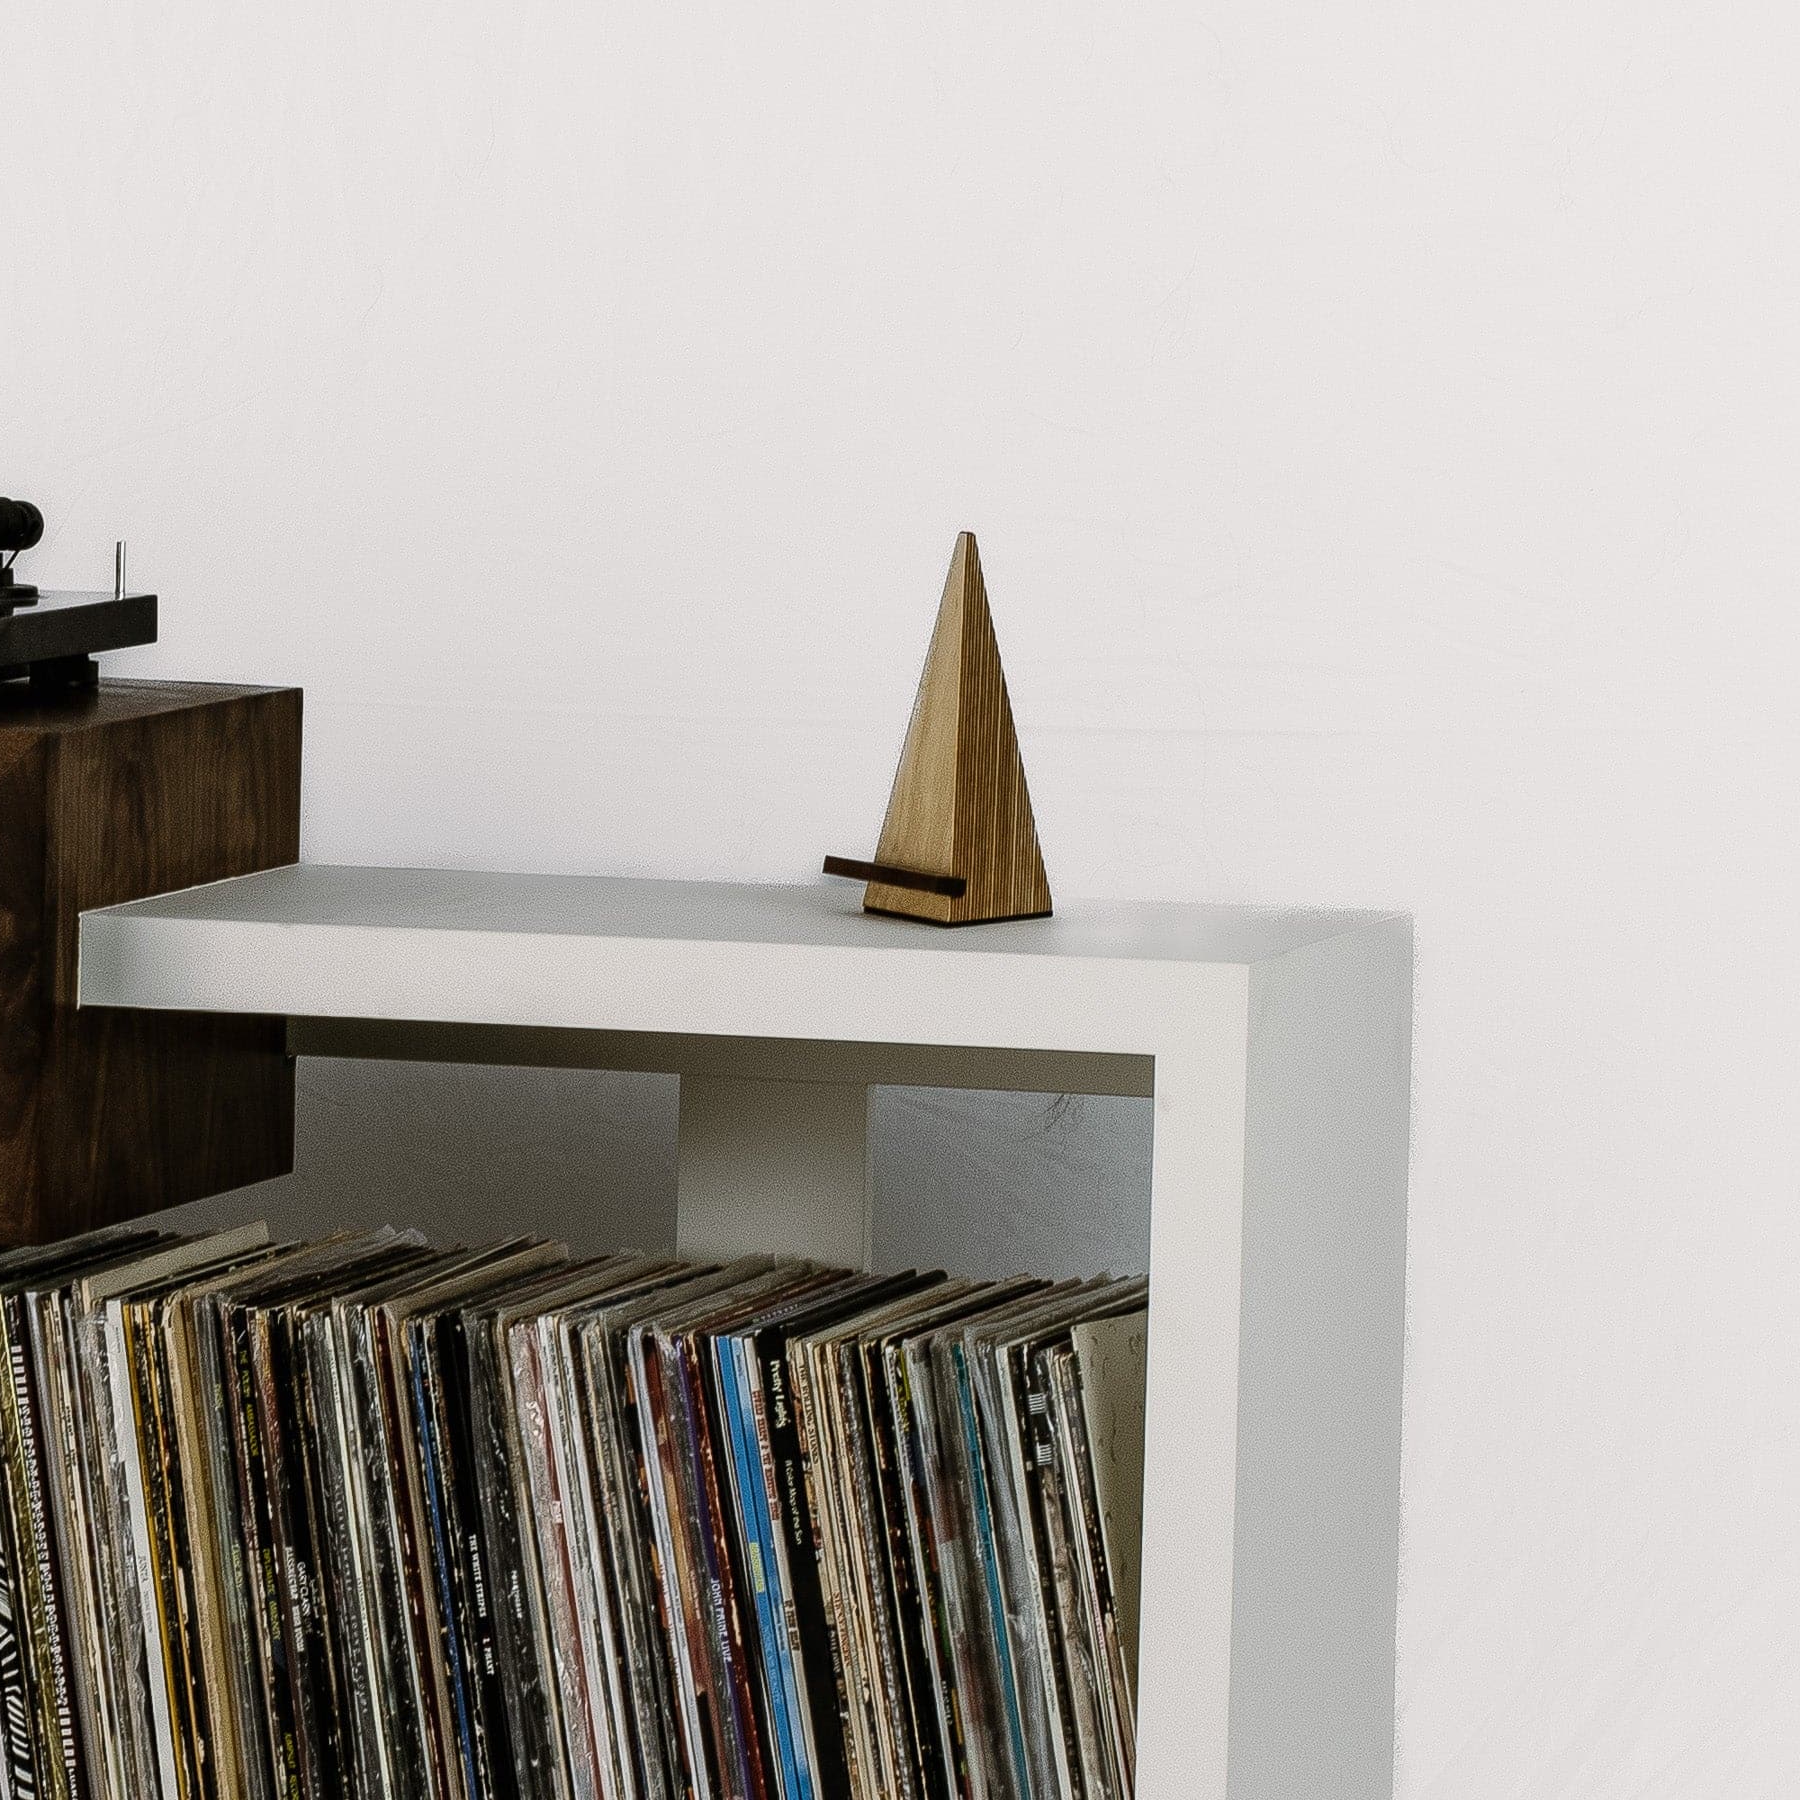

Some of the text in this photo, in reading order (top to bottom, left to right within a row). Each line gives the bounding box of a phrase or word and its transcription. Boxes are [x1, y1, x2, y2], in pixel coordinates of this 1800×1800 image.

[238, 1349, 249, 1364] THE
[240, 1368, 253, 1399] POLISH
[797, 1362, 809, 1384] THE
[767, 1358, 792, 1429] Pretty Lights
[800, 1384, 815, 1426] ROLLING
[244, 1402, 259, 1458] AMBASSADOR
[806, 1426, 821, 1465] STONES
[785, 1466, 796, 1487] Color
[786, 1486, 799, 1508] Map
[790, 1506, 800, 1515] of
[791, 1515, 802, 1529] the
[793, 1528, 804, 1545] Sun
[467, 1532, 478, 1552] THE
[261, 1547, 276, 1597] DIPLOMATIC
[283, 1545, 299, 1601] BASSNECTAR
[296, 1560, 308, 1586] GARY
[469, 1552, 482, 1582] WHITE
[298, 1585, 312, 1616] CLARK
[473, 1582, 487, 1618] STRIPES
[832, 1591, 846, 1626] STICKY
[708, 1575, 732, 1663] JOHN PRINE LIVE
[838, 1627, 853, 1668] FINGERS
